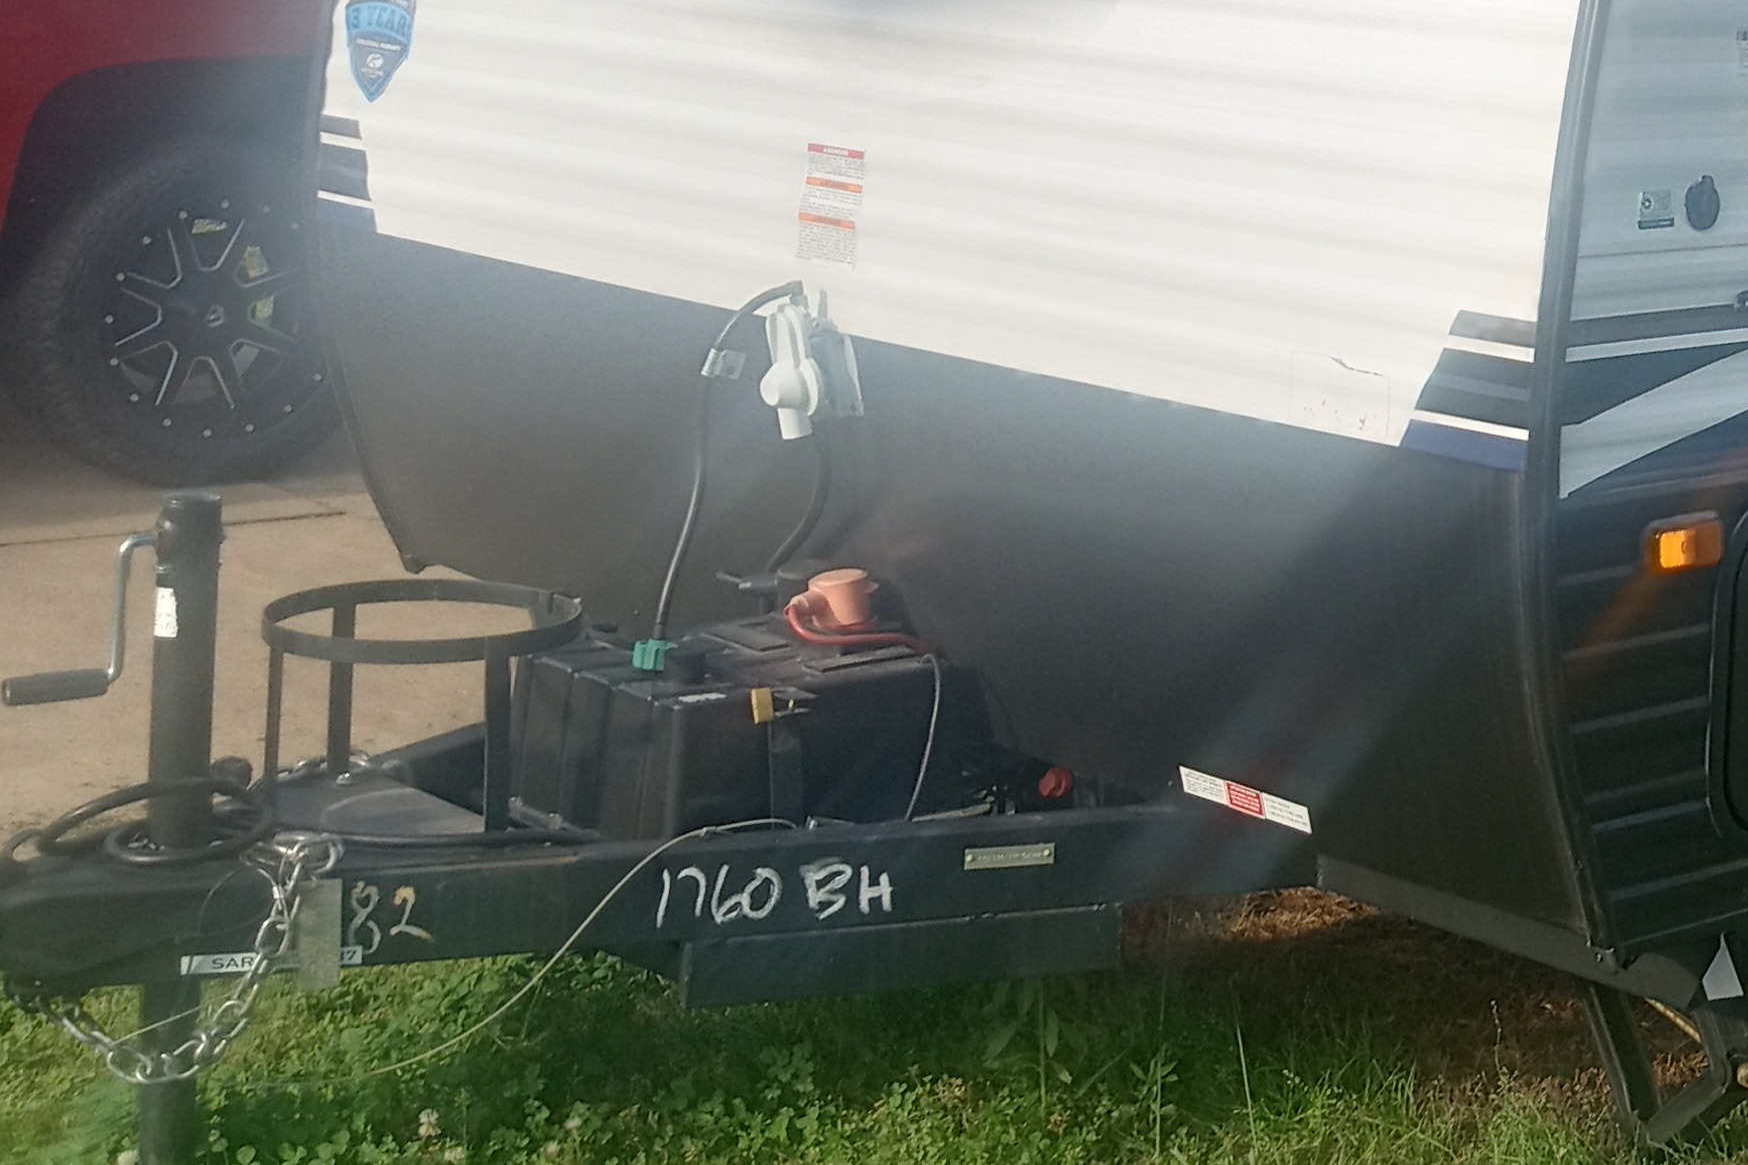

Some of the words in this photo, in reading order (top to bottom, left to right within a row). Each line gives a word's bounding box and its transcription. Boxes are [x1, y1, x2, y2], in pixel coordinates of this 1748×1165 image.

[350, 7, 361, 29] 3
[366, 5, 409, 39] YEAR
[656, 864, 782, 929] 1760
[800, 857, 893, 921] BH
